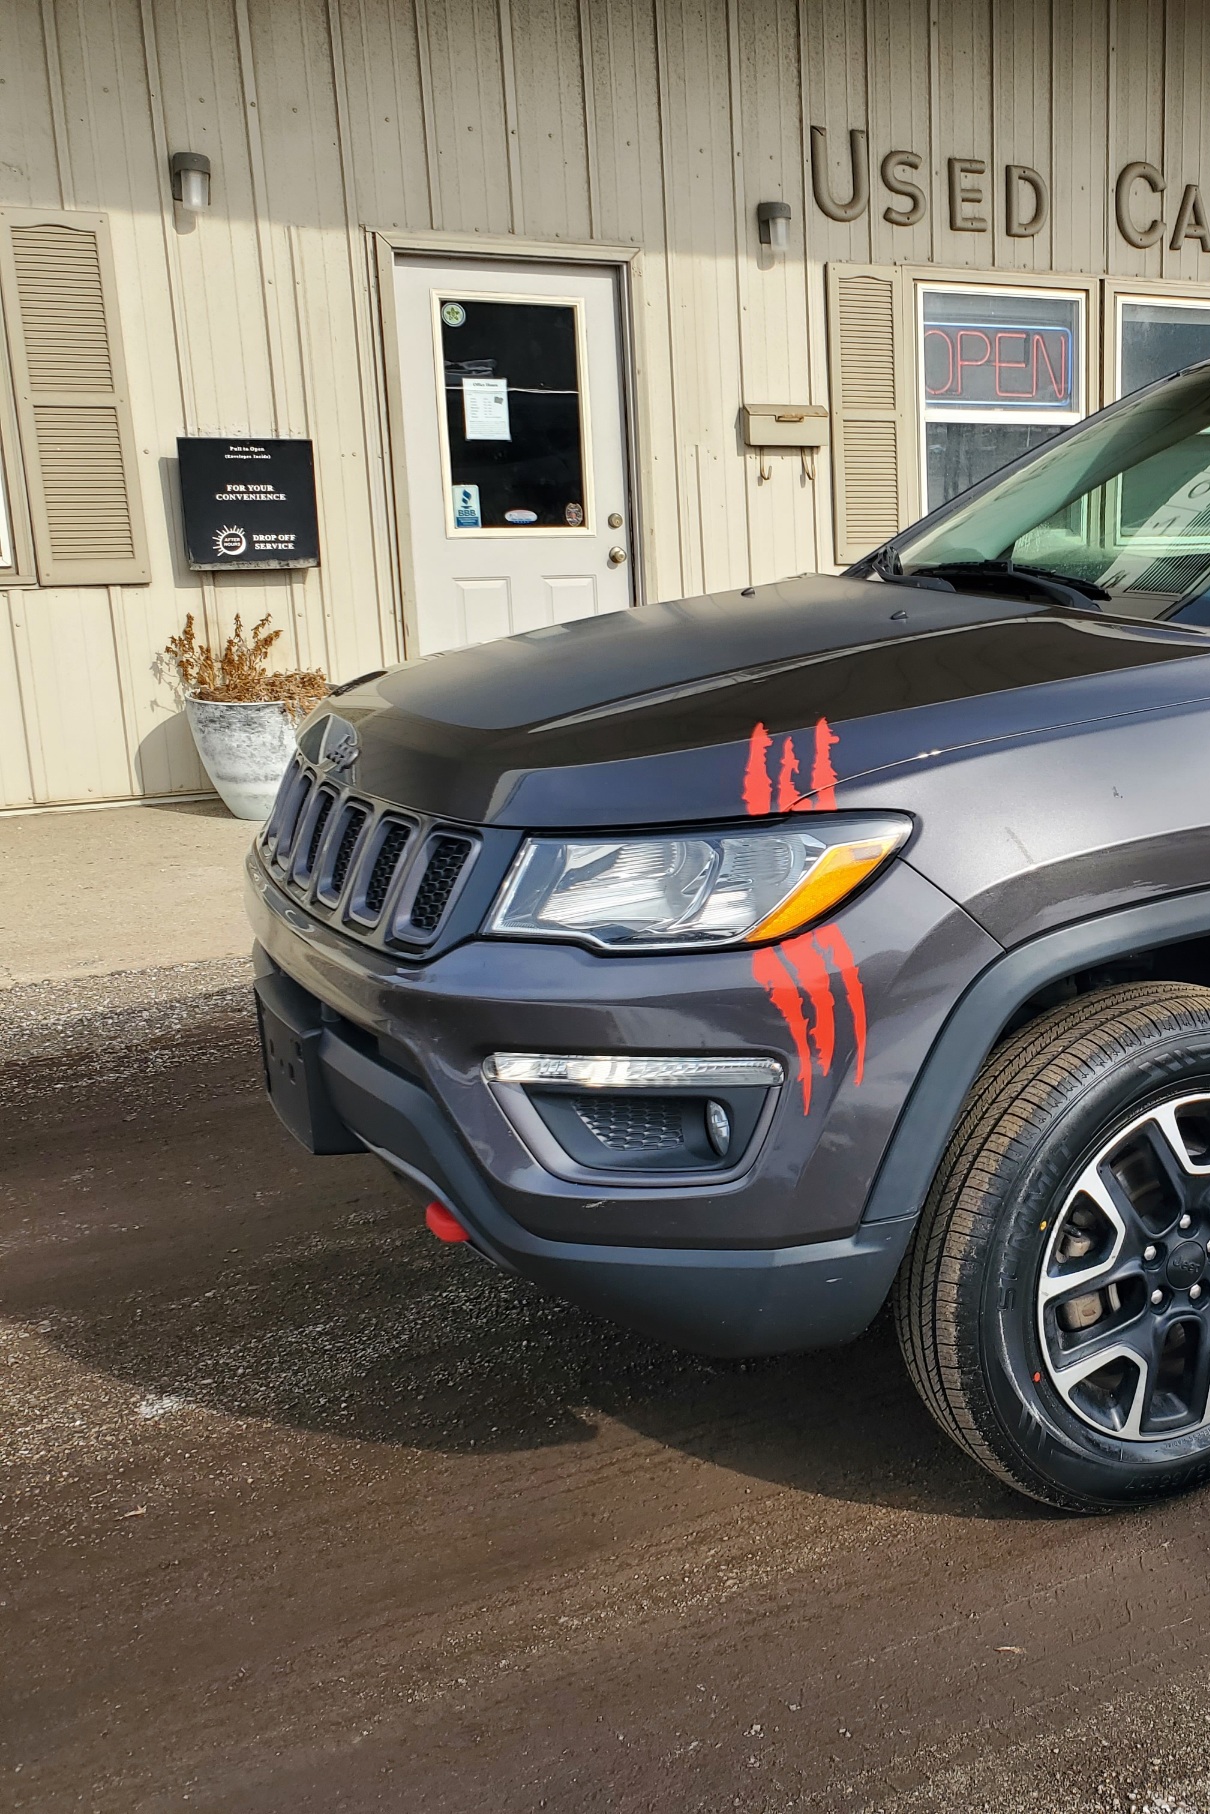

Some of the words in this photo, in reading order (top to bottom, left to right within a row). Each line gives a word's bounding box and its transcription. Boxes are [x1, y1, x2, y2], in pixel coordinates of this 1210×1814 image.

[810, 125, 1049, 237] USED
[924, 329, 1066, 399] OPEN
[215, 493, 287, 501] CONVENIENCE
[252, 534, 277, 542] DROP
[254, 542, 295, 550] SERVICE
